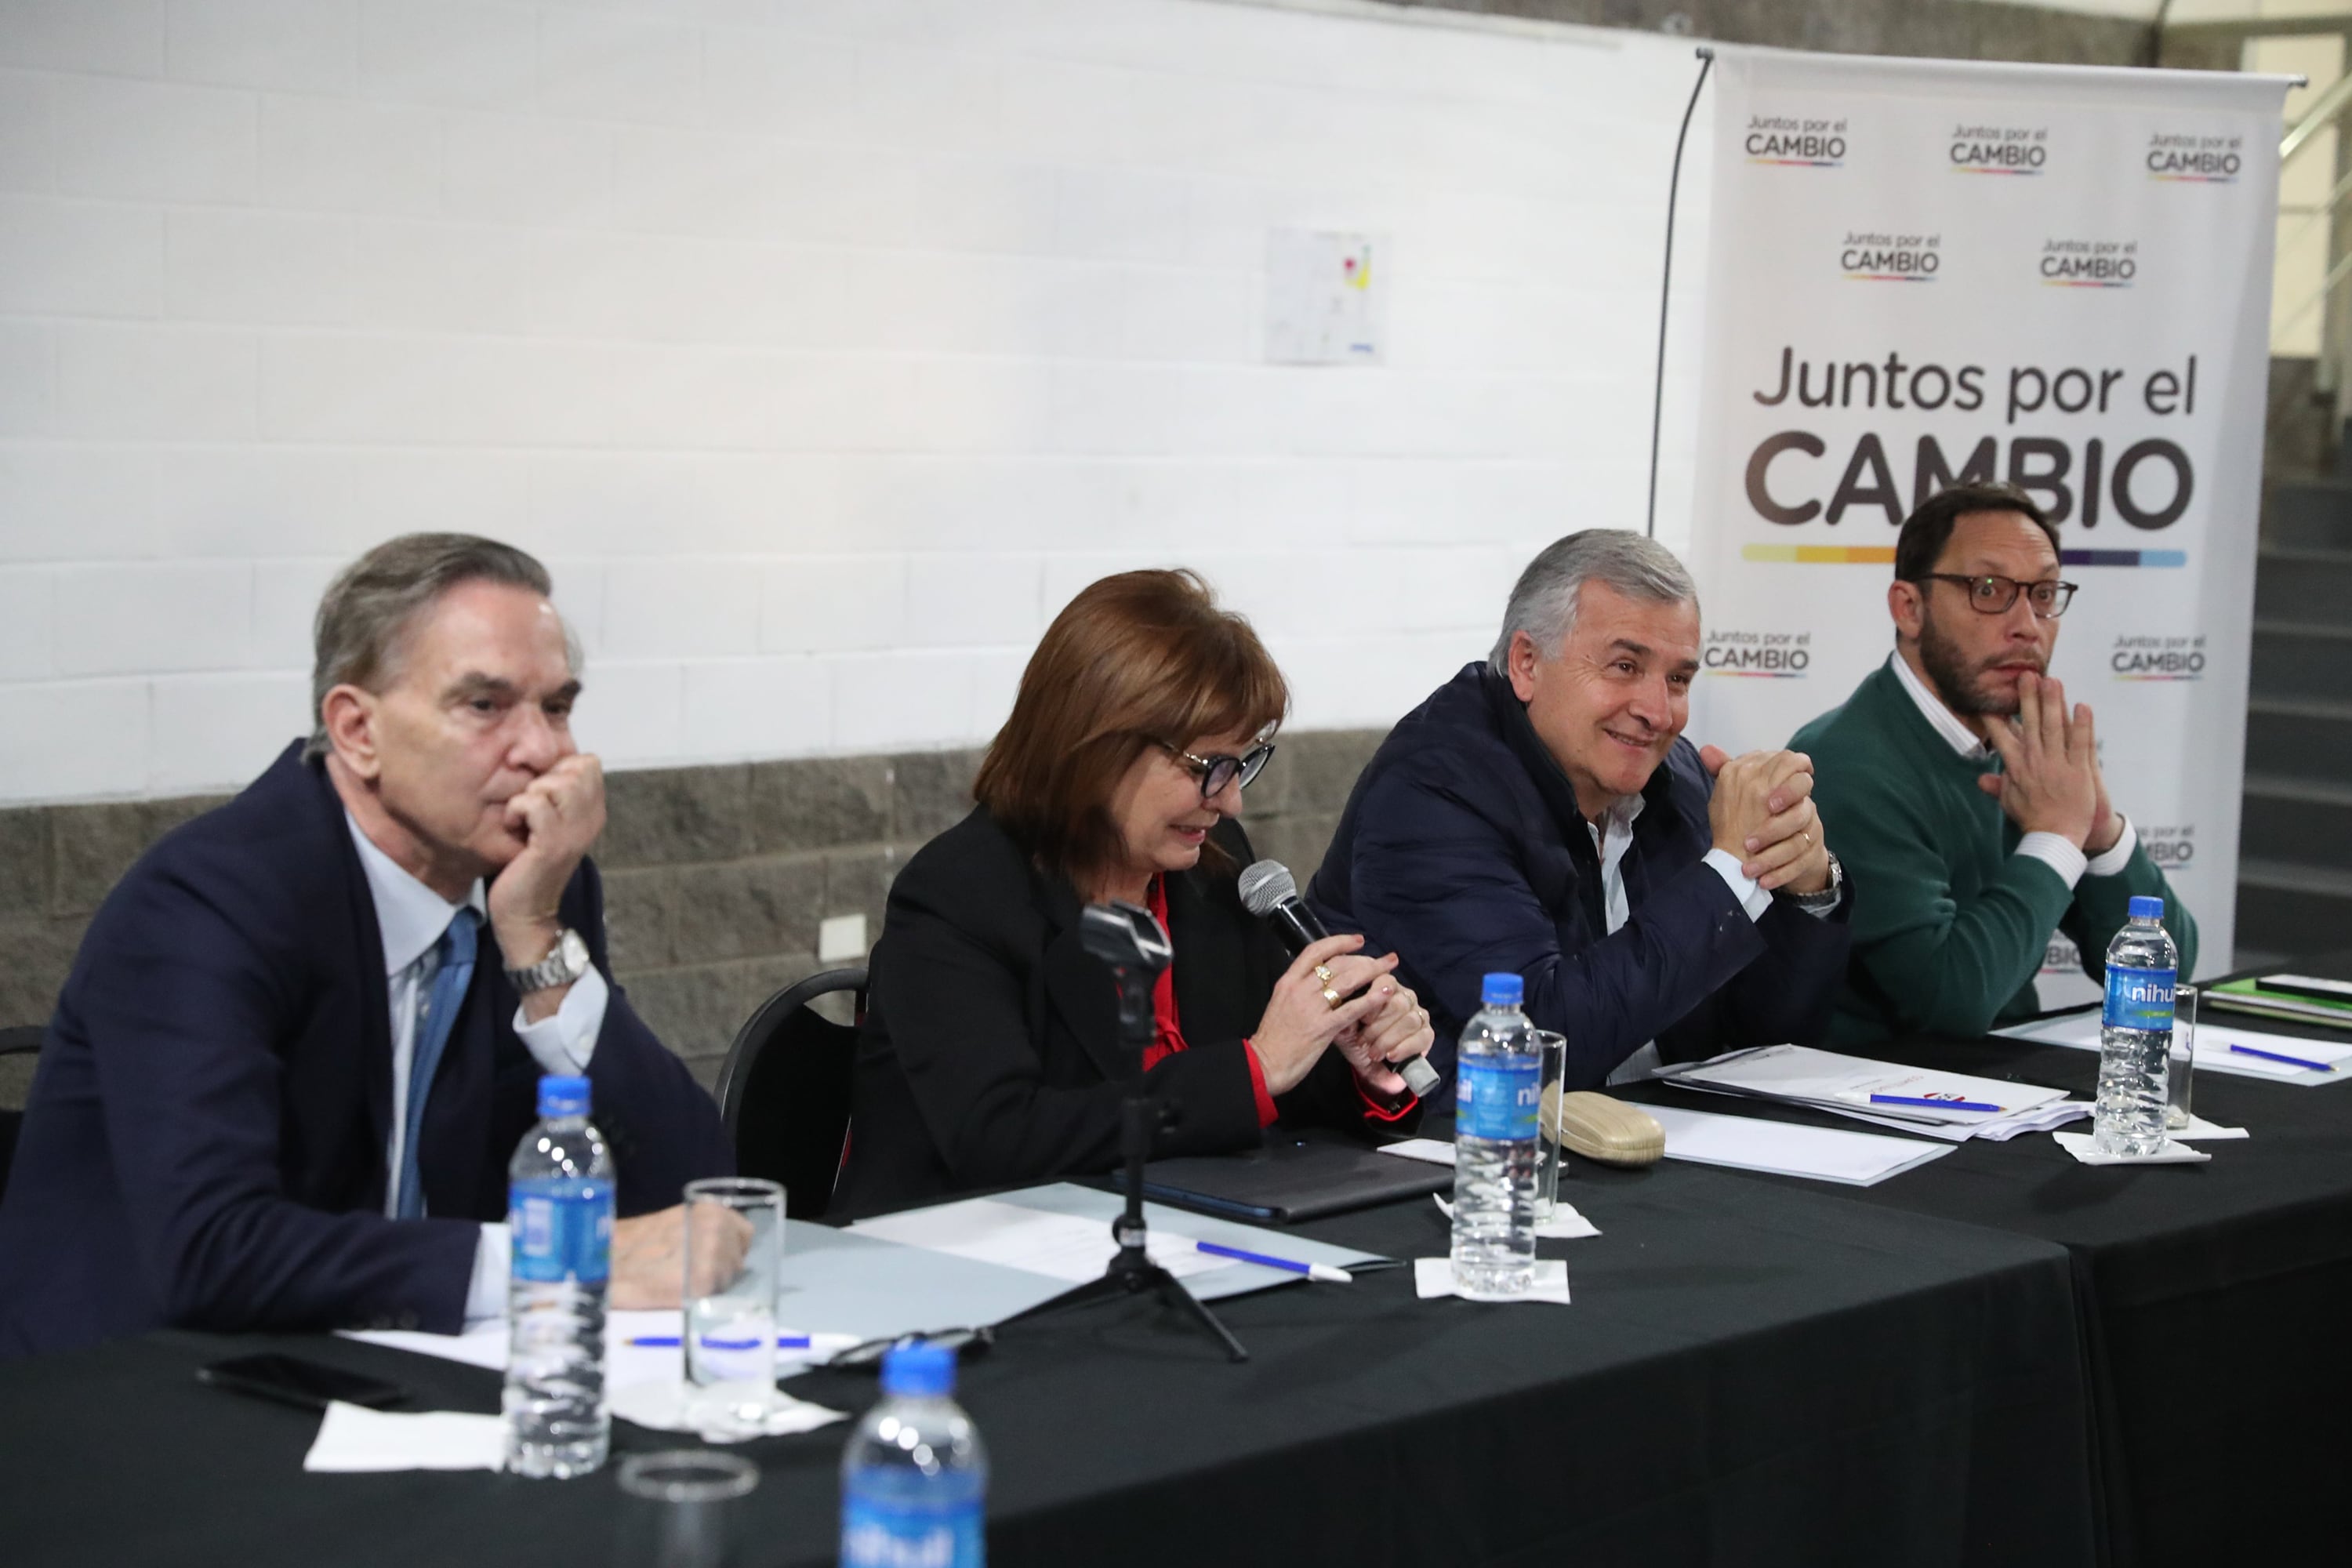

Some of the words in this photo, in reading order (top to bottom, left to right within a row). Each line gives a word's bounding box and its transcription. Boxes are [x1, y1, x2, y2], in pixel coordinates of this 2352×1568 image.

[1748, 115, 1799, 130] Juntos
[1802, 118, 1829, 132] por
[1833, 118, 1848, 132] el
[1952, 124, 2000, 139] Juntos
[2004, 127, 2030, 142] por
[2034, 125, 2049, 140] el
[1745, 133, 1846, 158] CAMBIO
[1950, 142, 2045, 167] CAMBIO
[2147, 150, 2241, 175] CAMBIO
[1844, 230, 1893, 246] Juntos
[1895, 234, 1922, 249] por
[1926, 234, 1940, 247] el
[1842, 249, 1940, 273] CAMBIO
[2040, 255, 2136, 279] CAMBIO
[1753, 346, 1985, 412] Juntos
[2007, 366, 2125, 426] por
[2143, 354, 2198, 415] el
[1744, 430, 2194, 532] CAMBIO
[1708, 630, 1759, 644] Juntos
[1763, 633, 1791, 646] por
[1795, 631, 1810, 645] el
[1704, 647, 1809, 670] CAMBIO
[2111, 651, 2205, 673] CAMBIO
